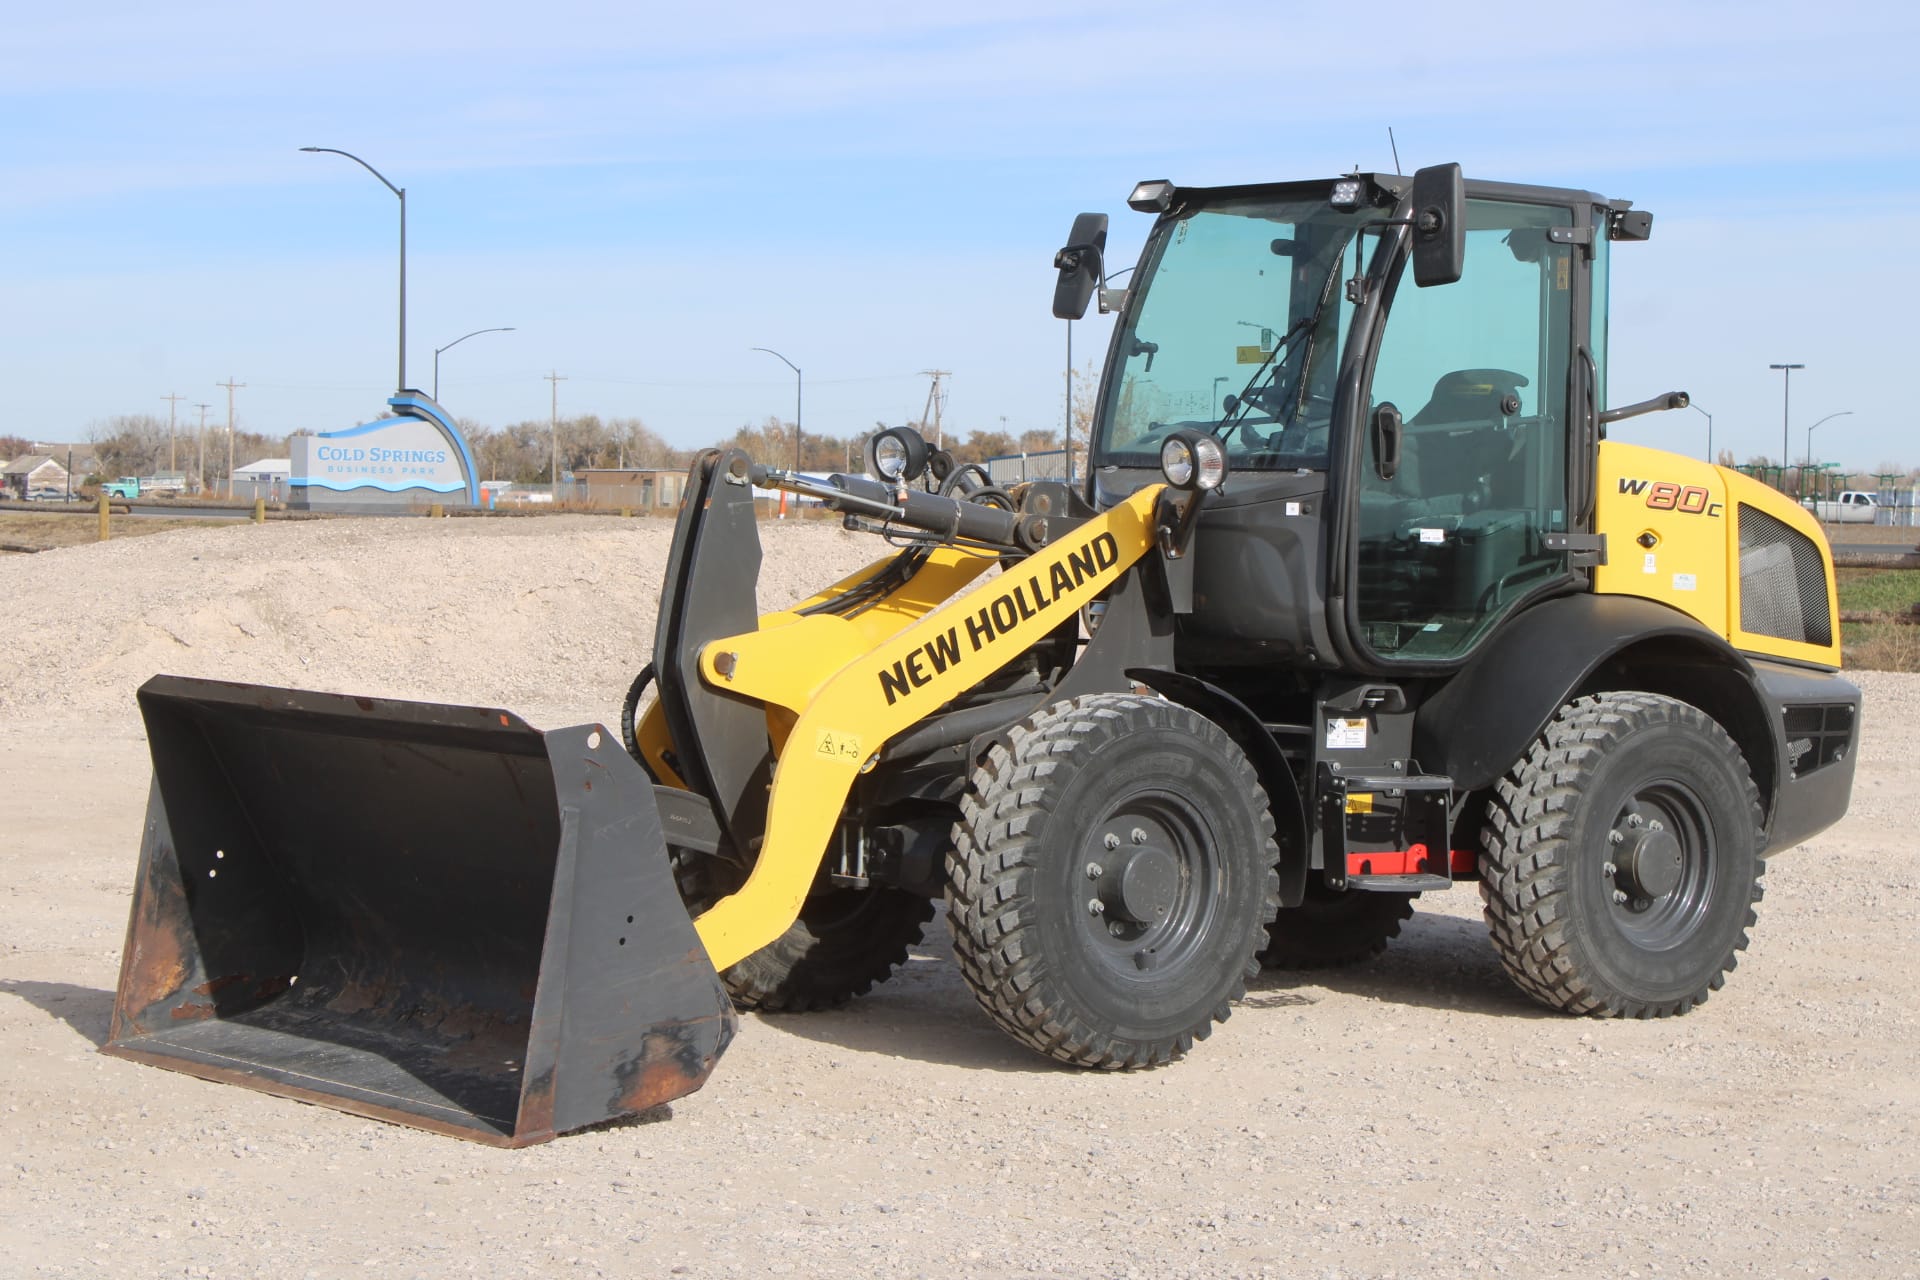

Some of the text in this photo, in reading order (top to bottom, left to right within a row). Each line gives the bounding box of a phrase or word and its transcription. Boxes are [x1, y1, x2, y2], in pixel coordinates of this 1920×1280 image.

[318, 446, 445, 463] COLD SPRINGS
[328, 465, 435, 475] BUSINESS PARK
[877, 531, 1119, 706] NEW HOLLAND
